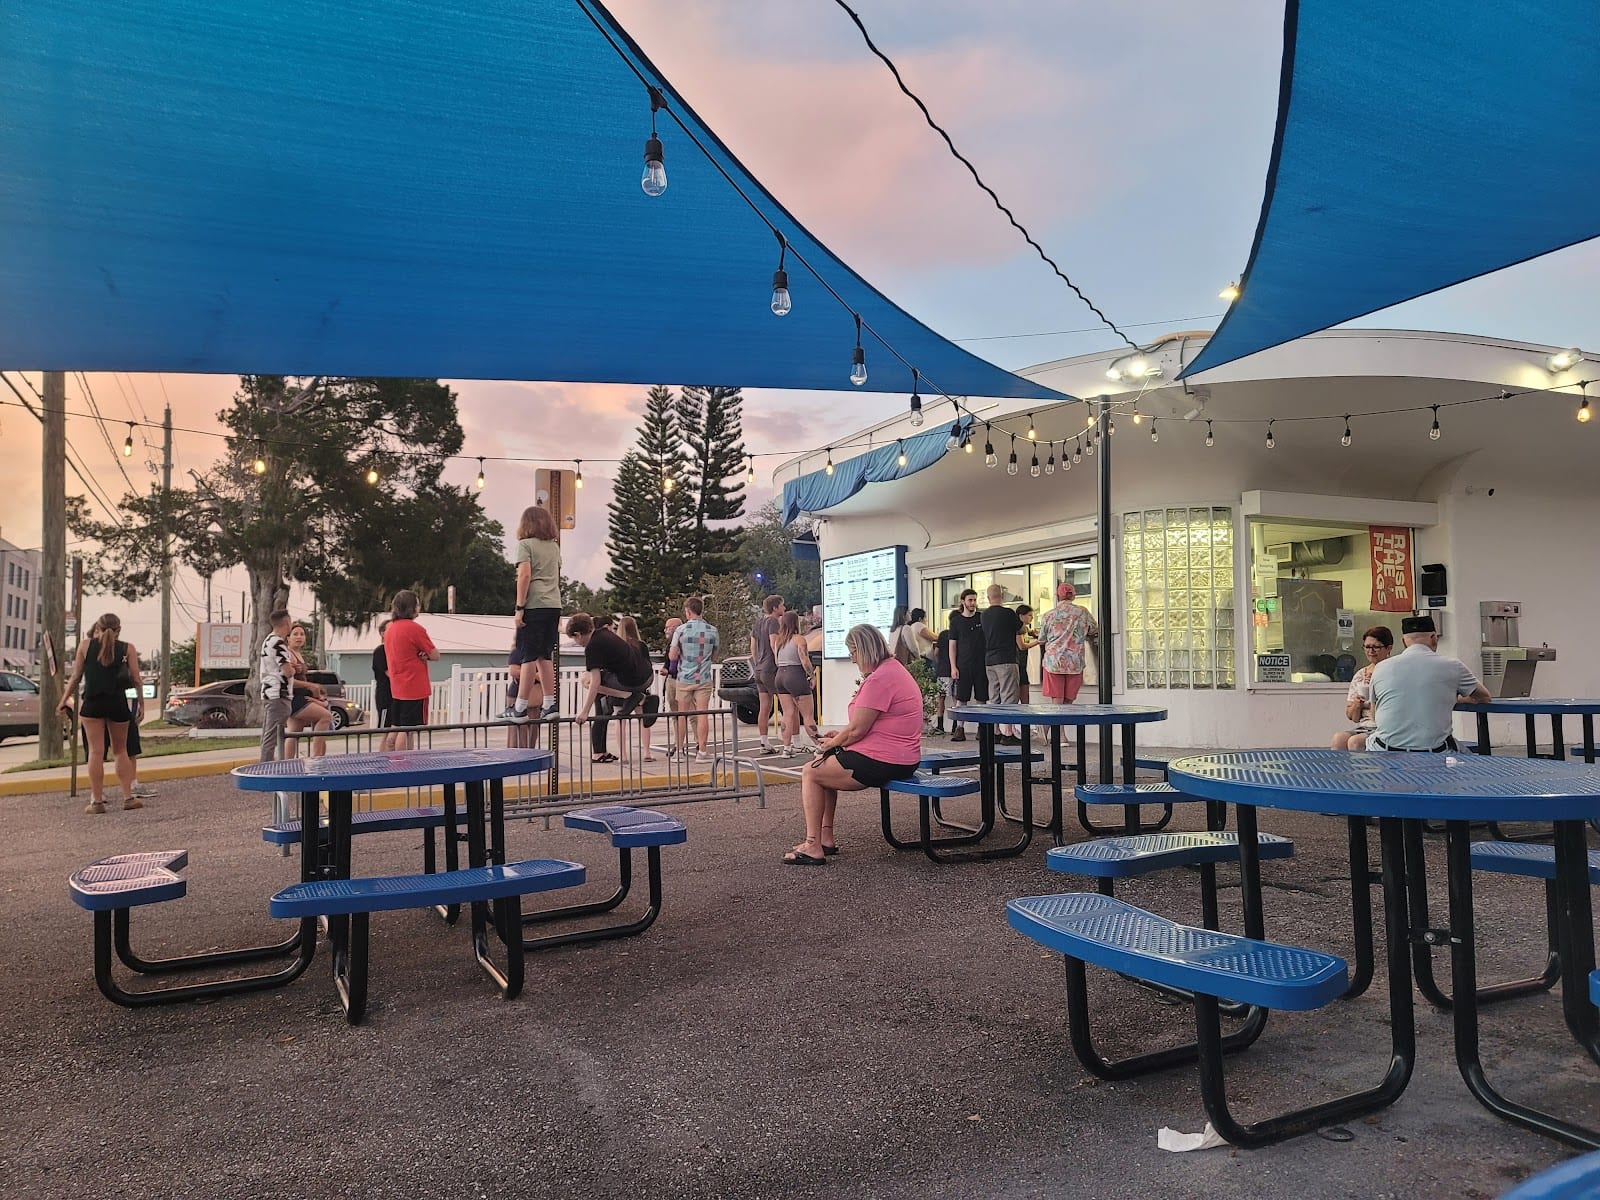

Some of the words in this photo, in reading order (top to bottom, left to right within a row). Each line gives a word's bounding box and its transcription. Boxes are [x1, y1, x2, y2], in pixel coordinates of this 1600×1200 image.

[1373, 532, 1387, 605] FLAGS
[1383, 533, 1396, 577] THE
[1394, 534, 1408, 599] RAISE
[1259, 656, 1289, 666] NOTICE
